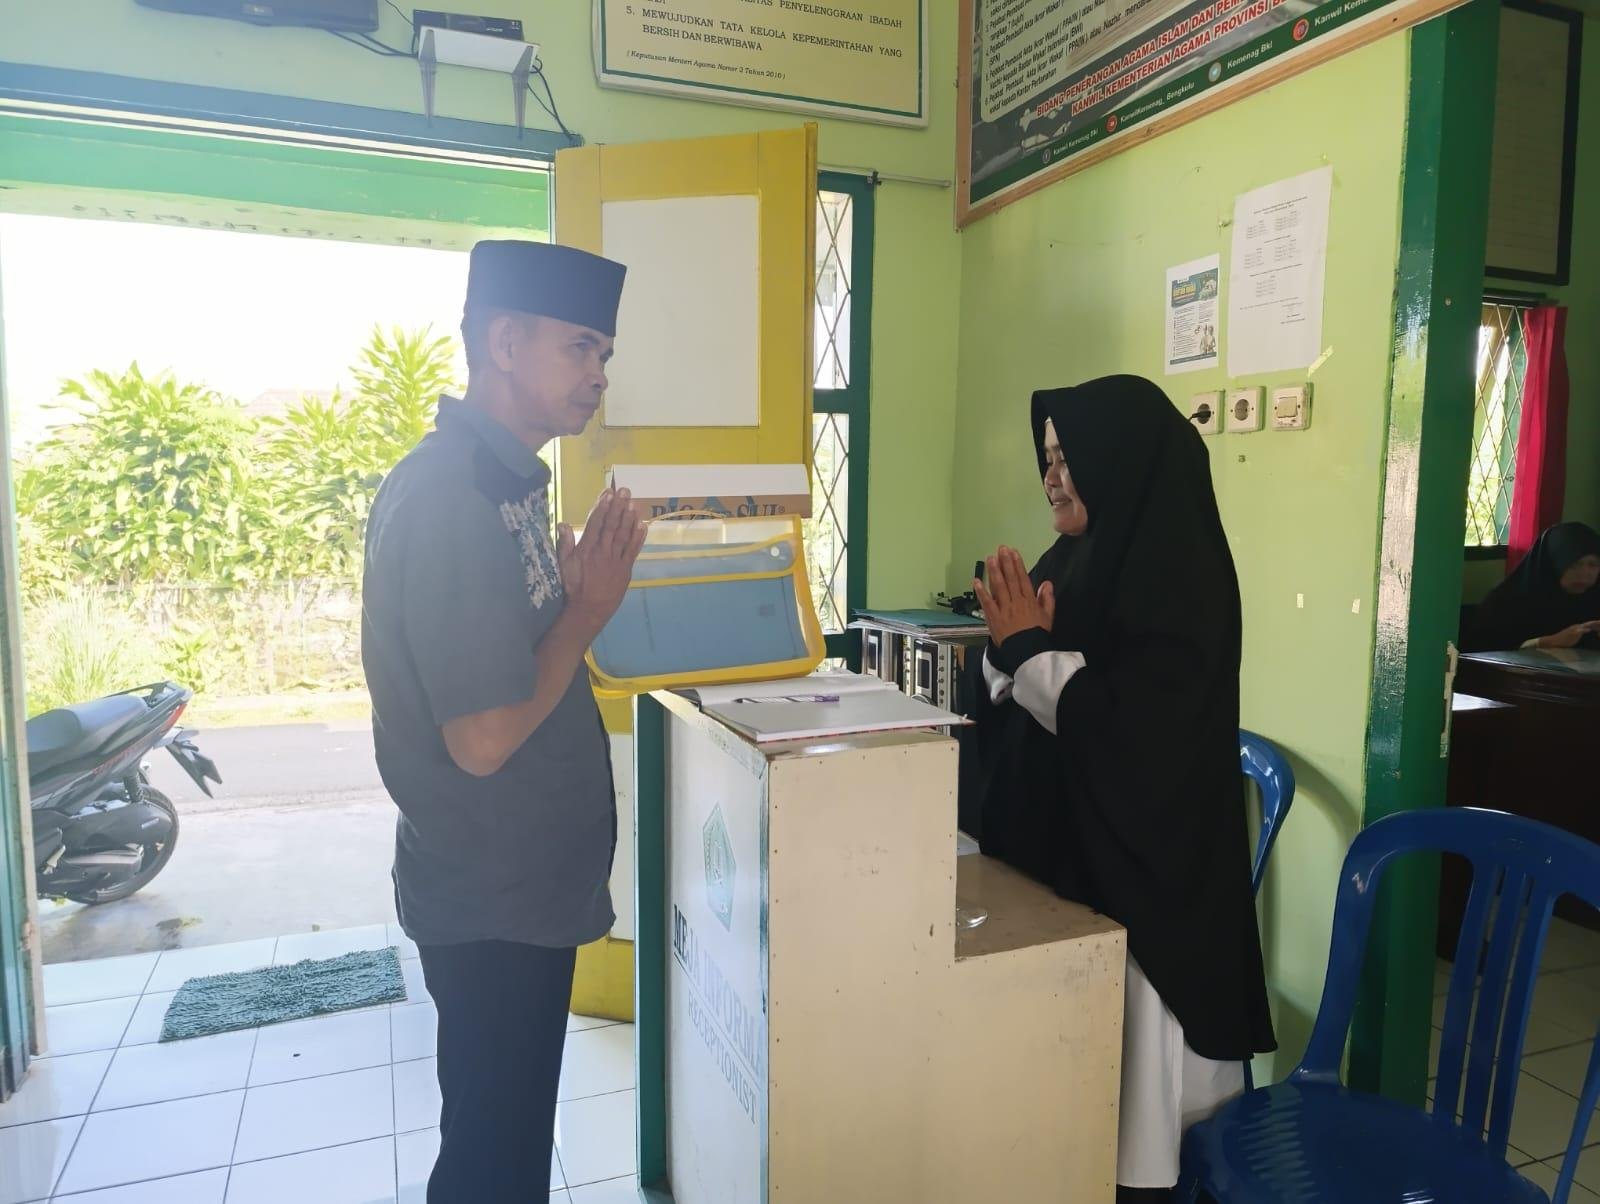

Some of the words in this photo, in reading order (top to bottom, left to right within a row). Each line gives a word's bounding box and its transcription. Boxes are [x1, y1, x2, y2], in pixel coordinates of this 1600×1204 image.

[780, 1, 863, 21] PENYELENGGRAAN
[870, 15, 902, 28] IBADAH
[1314, 6, 1343, 27] Kanwil
[626, 6, 635, 15] 5.
[642, 8, 714, 28] MEWUJUDKAN
[720, 21, 744, 33] TATA
[750, 26, 786, 40] KELOLA
[792, 32, 873, 53] KEPEMERINTAHAN
[879, 46, 902, 58] YANG
[642, 24, 680, 38] BERSIH
[682, 30, 702, 41] DAN
[703, 34, 762, 51] BERWIBAWA
[631, 50, 667, 61] Keputusan
[668, 55, 692, 66] Menteri
[693, 60, 716, 69] Agama
[745, 67, 765, 77] Tahun
[1036, 92, 1065, 117] BIDANG
[1064, 59, 1121, 100] PENERANGAN
[1122, 39, 1156, 71] AGAMA
[1157, 20, 1190, 50] ISLAM
[1190, 8, 1214, 30] DAN
[1071, 86, 1105, 116] KANWIL
[1104, 50, 1172, 98] KEMENTERIAN
[1171, 30, 1212, 61] AGAMA
[1212, 0, 1270, 40] PROVINSI
[1227, 50, 1260, 70] Kemenag
[1260, 40, 1273, 54] Bkl
[1166, 81, 1196, 101] Bengkulu
[673, 903, 701, 988] MEJA
[688, 986, 756, 1125] RECEPTIONIST
